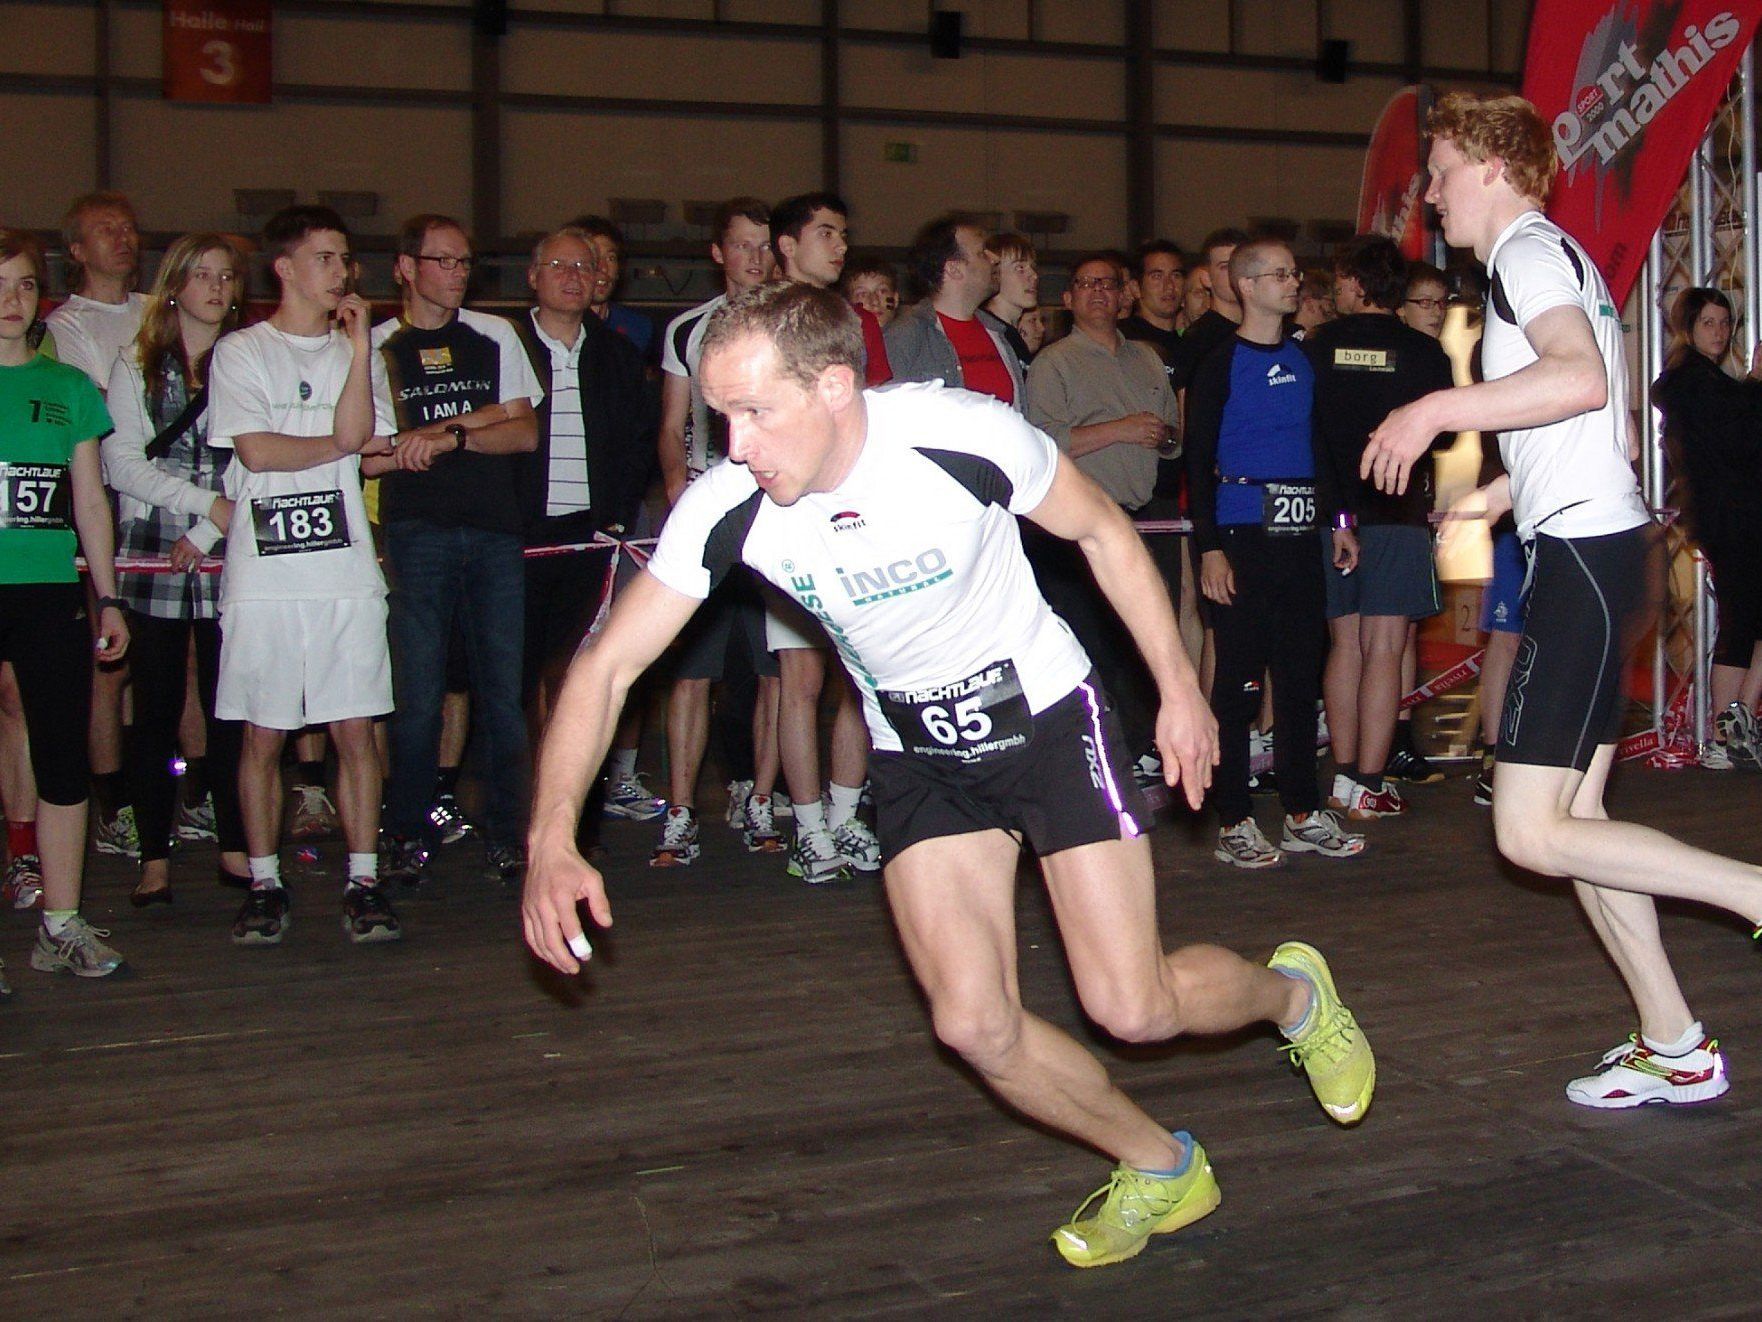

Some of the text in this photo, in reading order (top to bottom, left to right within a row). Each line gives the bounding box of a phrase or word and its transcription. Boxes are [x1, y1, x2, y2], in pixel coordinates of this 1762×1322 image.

[170, 10, 227, 30] Halle
[200, 40, 235, 85] 3
[1577, 88, 1599, 113] SPORT
[1593, 12, 1740, 166] mathis
[1344, 350, 1377, 365] borg
[1268, 374, 1297, 387] skinfit
[423, 400, 472, 421] I AM A
[1274, 496, 1316, 523] 205
[269, 506, 334, 541] 183
[833, 519, 866, 533] skinfit
[921, 695, 993, 746] 65
